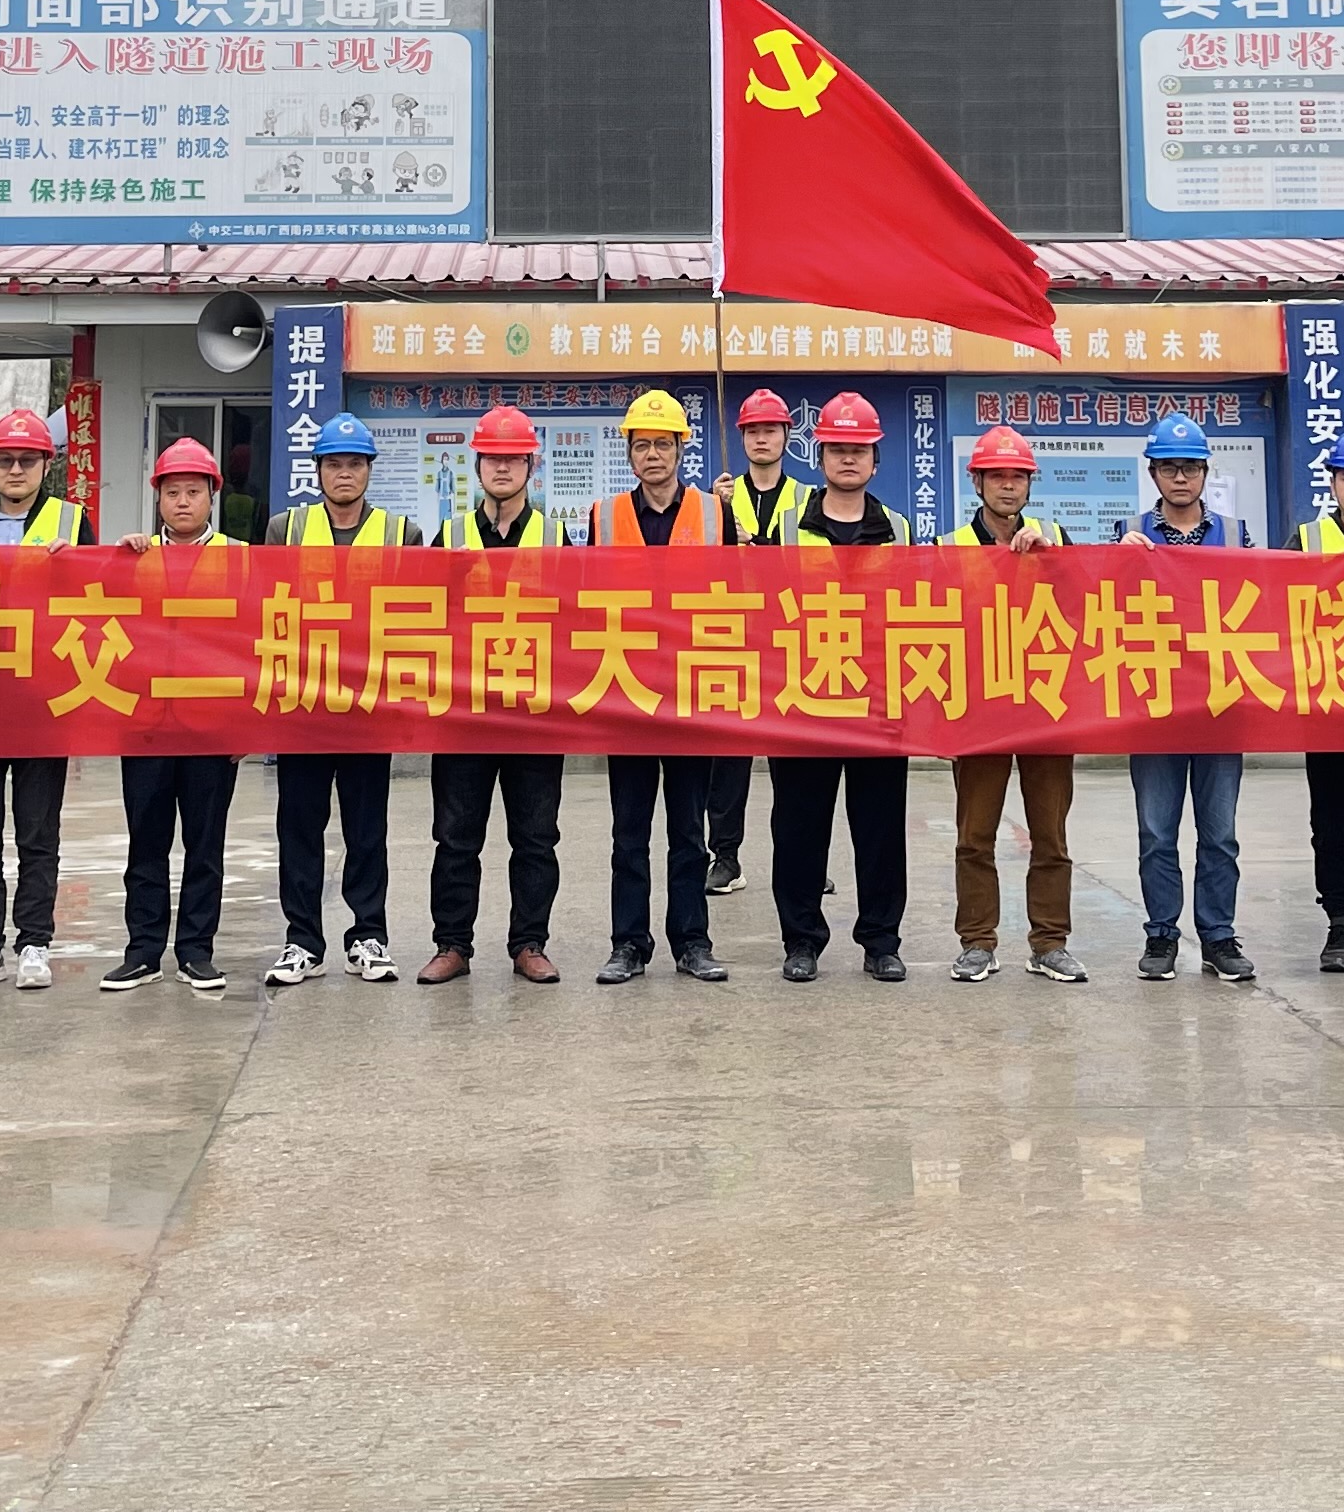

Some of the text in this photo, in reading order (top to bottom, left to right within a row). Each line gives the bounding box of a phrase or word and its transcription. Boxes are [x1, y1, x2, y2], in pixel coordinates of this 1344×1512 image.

[30, 177, 207, 202] 保持绿色施工
[372, 323, 486, 356] 班前安全
[550, 322, 661, 356] 教育讲台
[681, 323, 813, 357] 外树企业信誉
[821, 324, 953, 357] 内育职业忠诚
[286, 325, 326, 509] 提升全员
[681, 393, 705, 489] 落实安
[976, 391, 1241, 426] 隧道施工信息公开栏
[913, 394, 937, 545] 强化安全防
